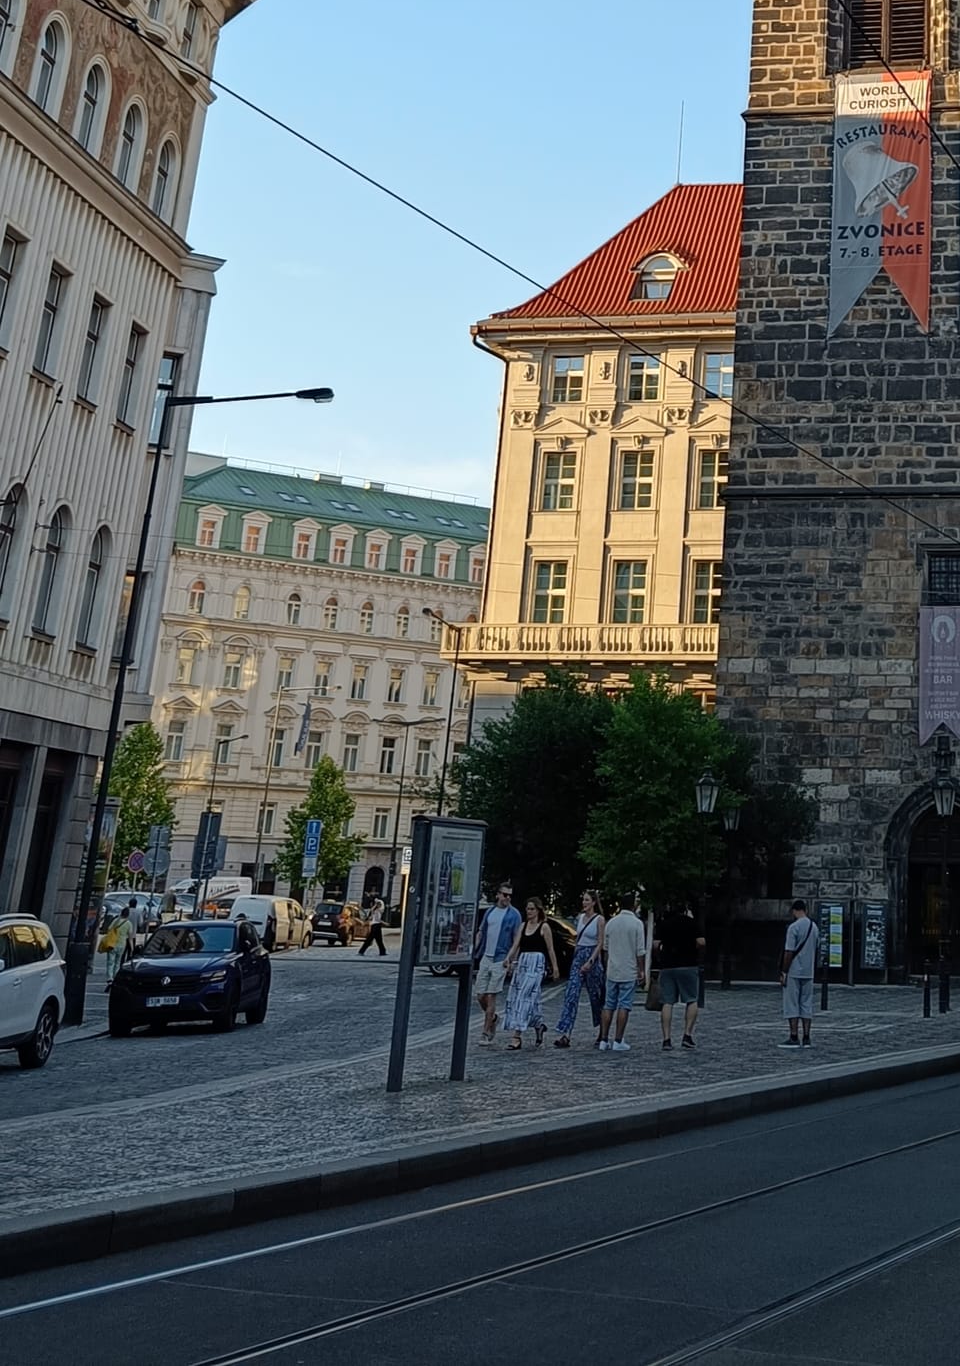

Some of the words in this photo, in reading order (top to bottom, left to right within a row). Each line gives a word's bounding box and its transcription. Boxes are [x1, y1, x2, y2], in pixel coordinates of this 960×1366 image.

[836, 123, 928, 148] RESTAURANT
[837, 221, 925, 240] ZVONICE
[879, 243, 923, 257] ETAGE
[933, 675, 953, 684] BAR
